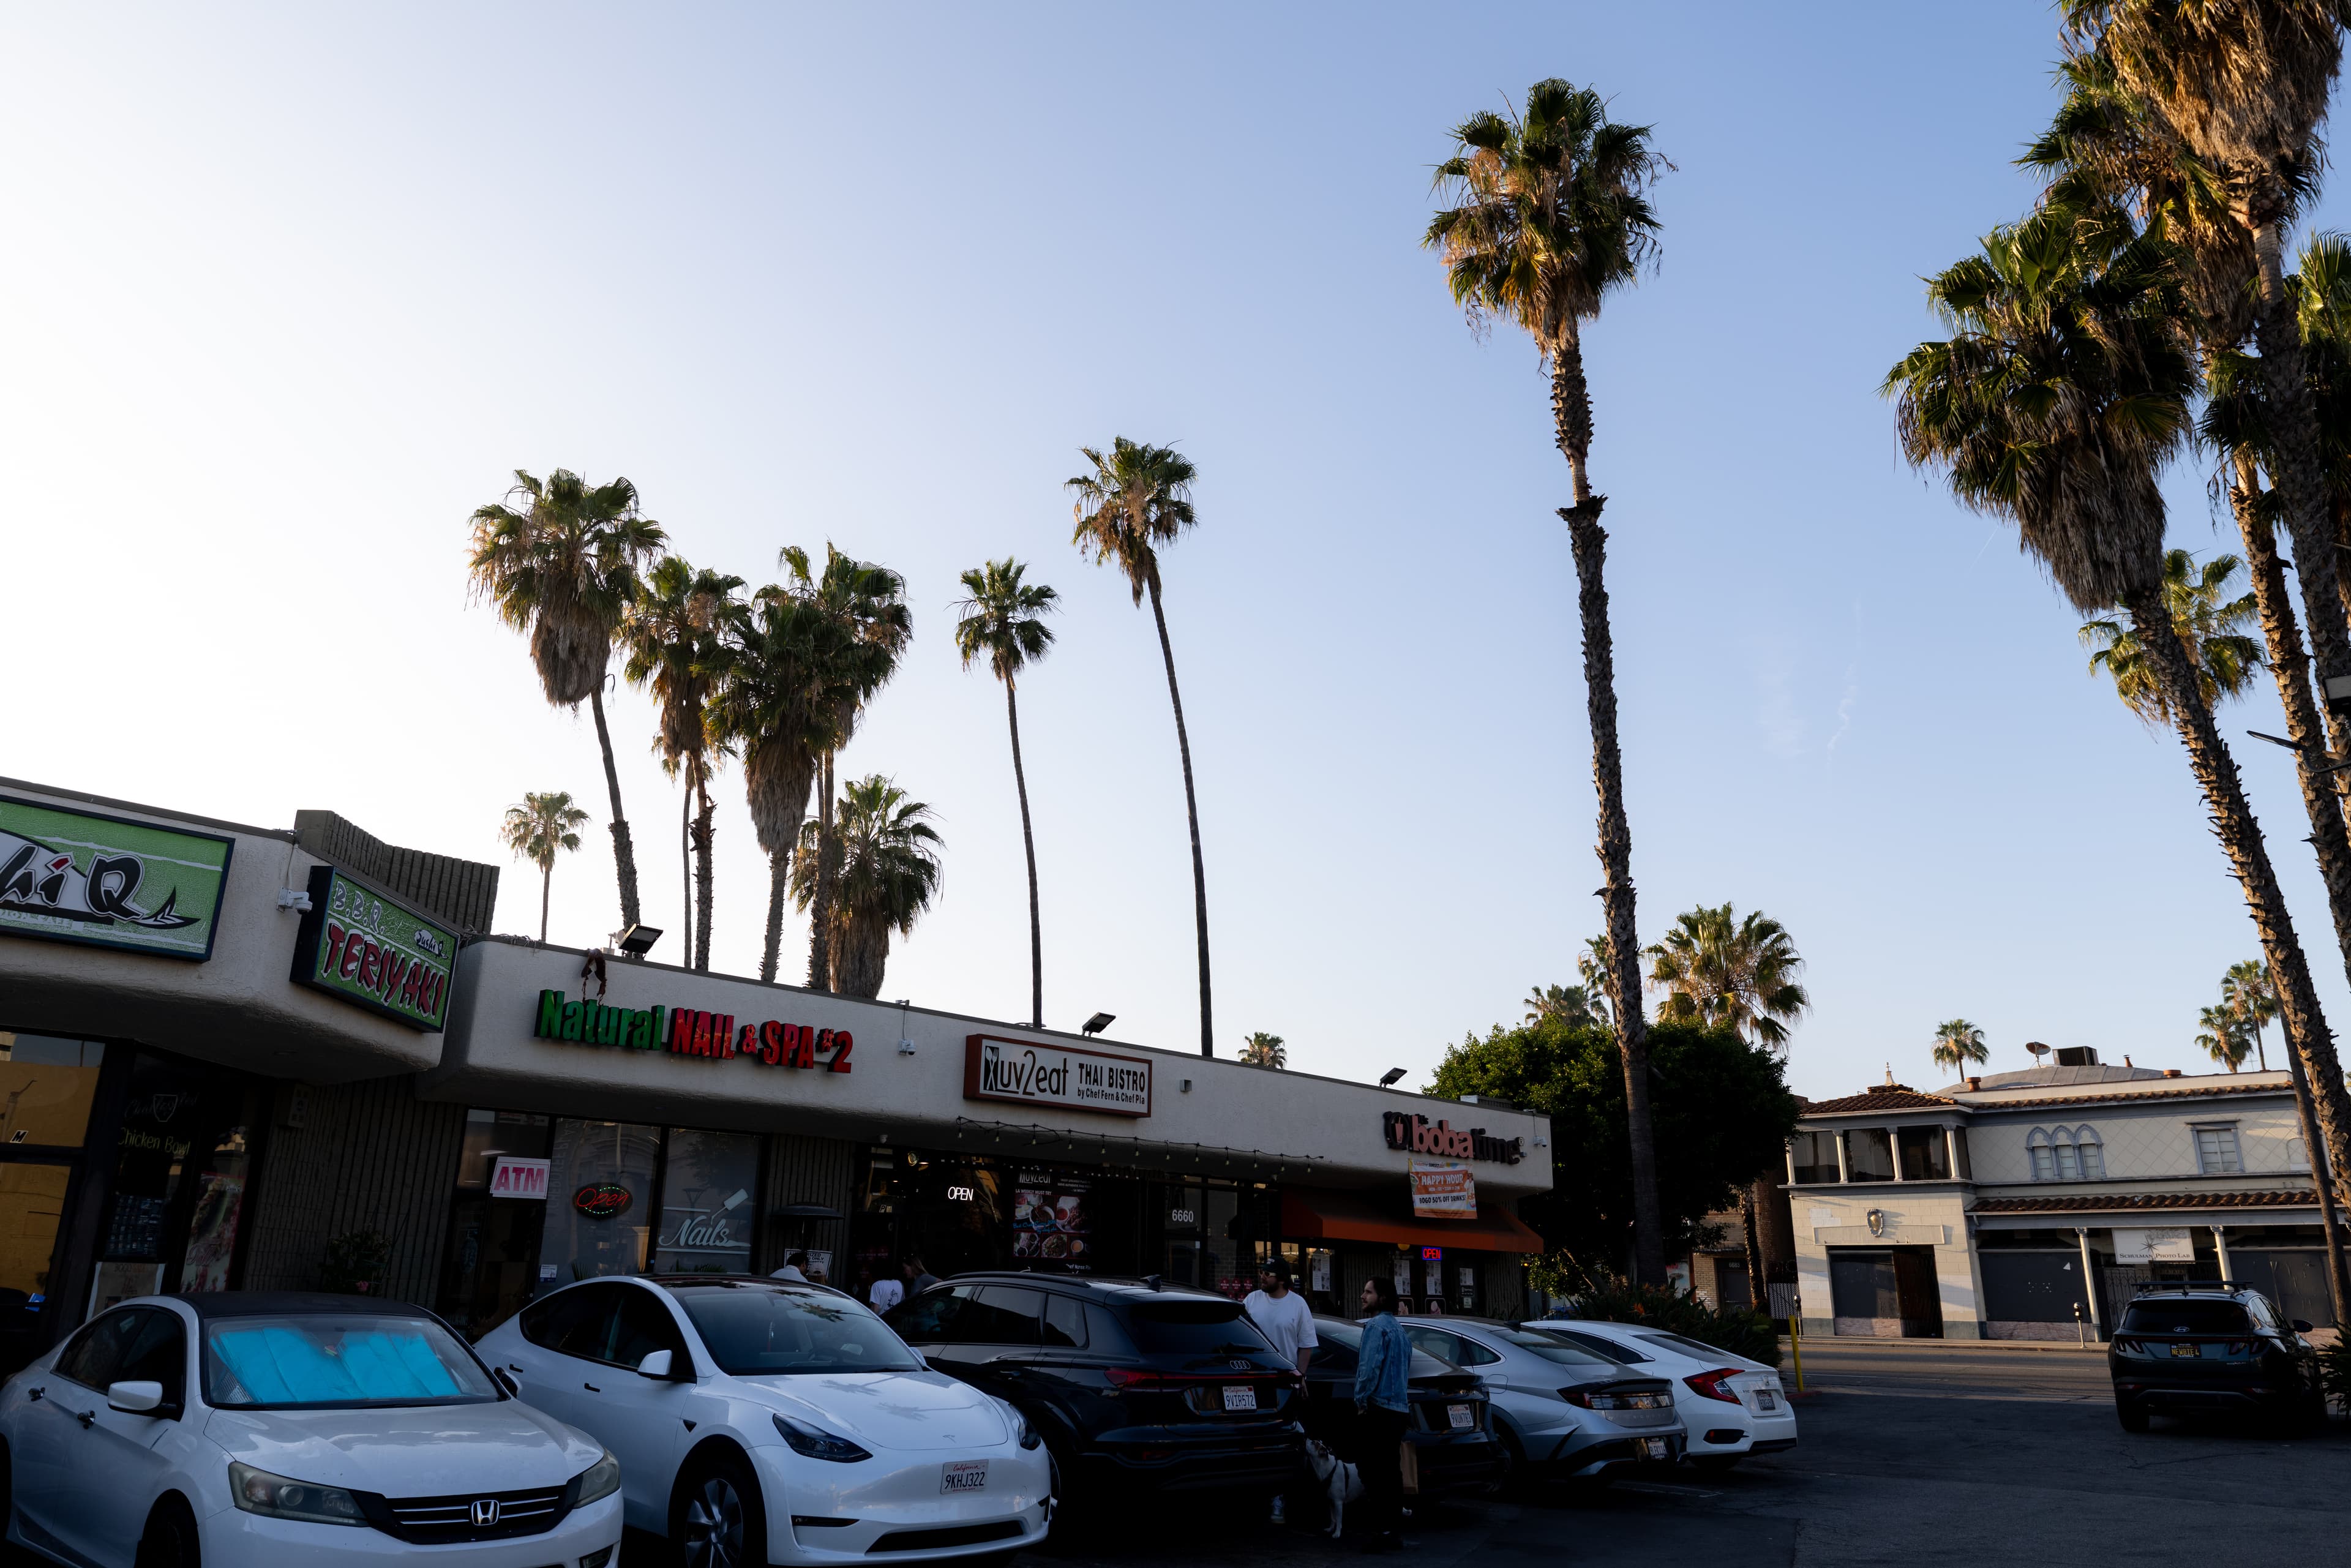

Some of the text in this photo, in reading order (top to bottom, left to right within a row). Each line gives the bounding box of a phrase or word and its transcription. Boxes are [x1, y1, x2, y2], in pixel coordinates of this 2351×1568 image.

[84, 853, 147, 920] Q
[334, 881, 385, 934] B.B.Q.
[323, 920, 445, 1018] TERIYAKI
[534, 988, 666, 1051] Natural
[666, 1007, 735, 1060] NAIL
[737, 1024, 758, 1054] &
[757, 1021, 814, 1069] SPA
[1079, 1063, 1145, 1092] THAI BISTRO
[1078, 1087, 1145, 1105] by Chef Fern & Chef Pla
[493, 1166, 545, 1191] ATM
[1421, 1174, 1463, 1186] HAPPY HOUR
[576, 1187, 629, 1209] Open
[948, 1186, 973, 1201] OPEN
[1172, 1209, 1194, 1223] 6660
[658, 1215, 733, 1247] Nails
[1423, 1248, 1441, 1259] OPEN
[1226, 1395, 1255, 1407] 9VIR572
[953, 1464, 980, 1472] California
[944, 1471, 985, 1490] 9KHJ322
